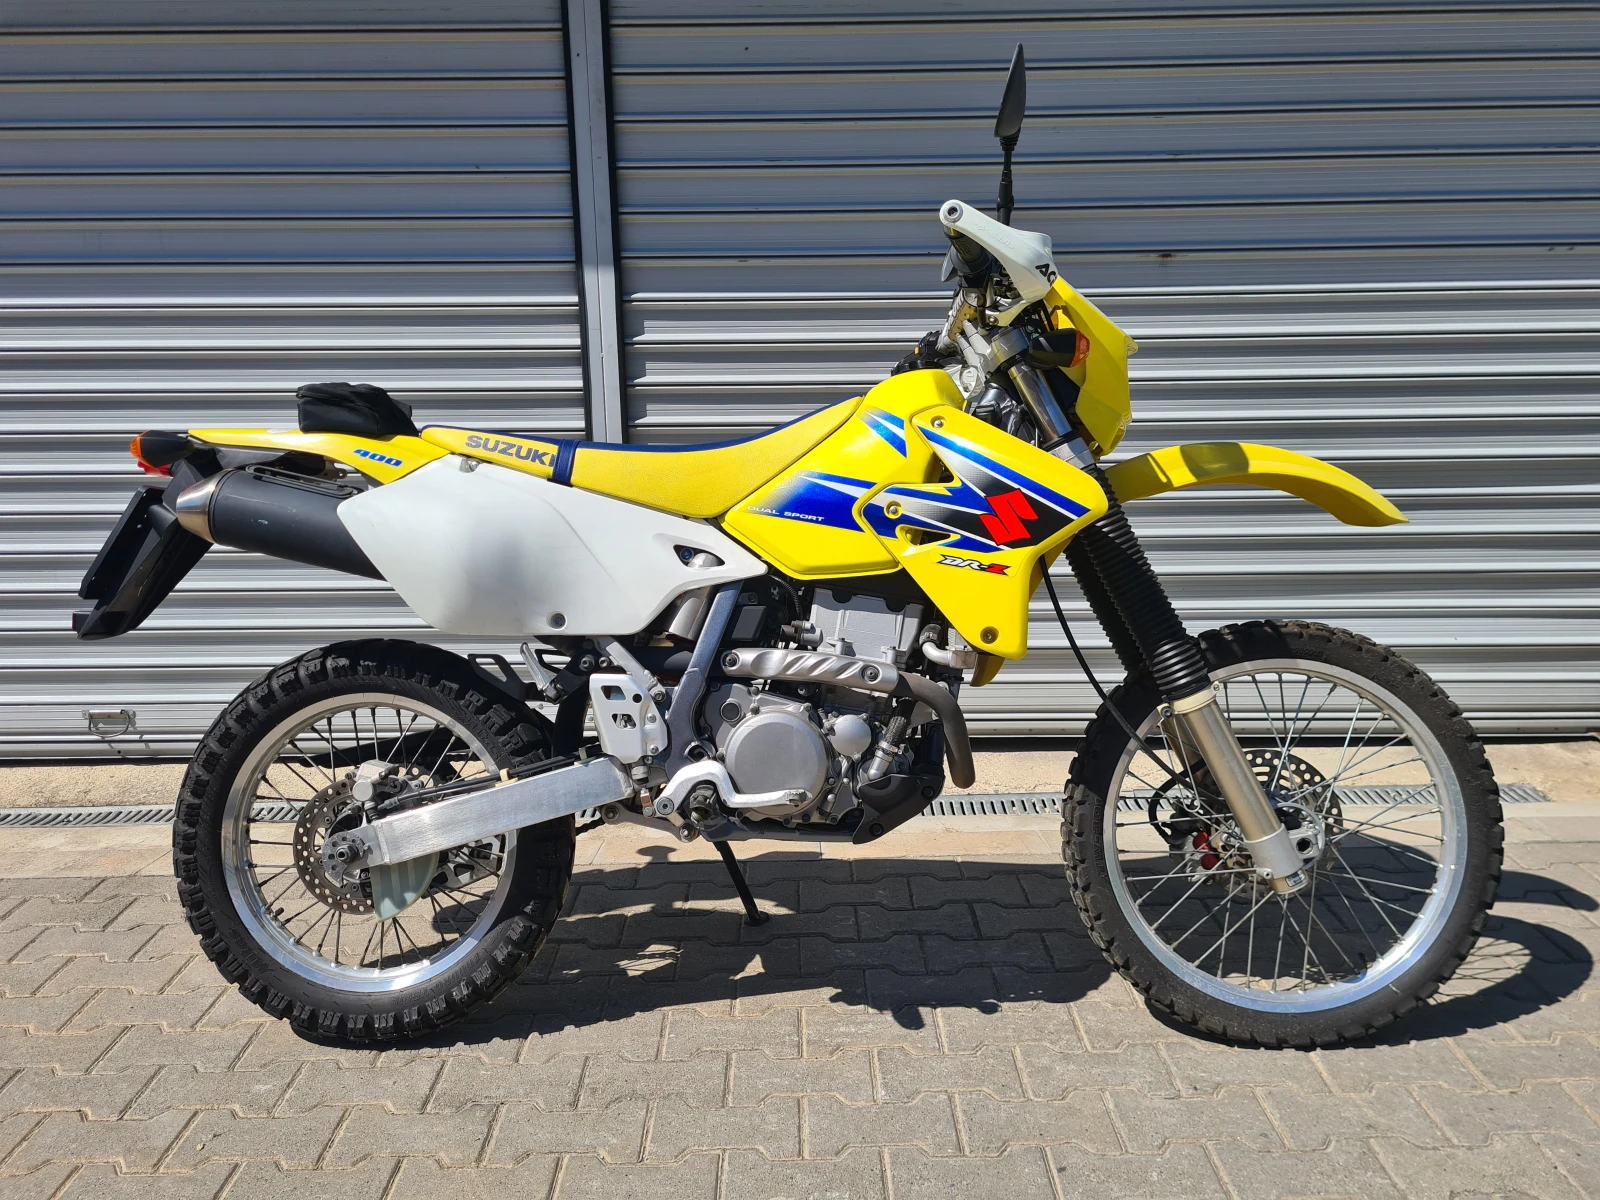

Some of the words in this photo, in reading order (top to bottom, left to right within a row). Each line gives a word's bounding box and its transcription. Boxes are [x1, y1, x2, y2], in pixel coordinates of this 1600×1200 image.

[1035, 263, 1057, 287] AC
[353, 448, 403, 467] 400
[464, 434, 557, 468] SUZUKI
[747, 506, 780, 515] DUAL
[783, 511, 825, 522] SPORT
[936, 554, 1012, 576] DR-Z
